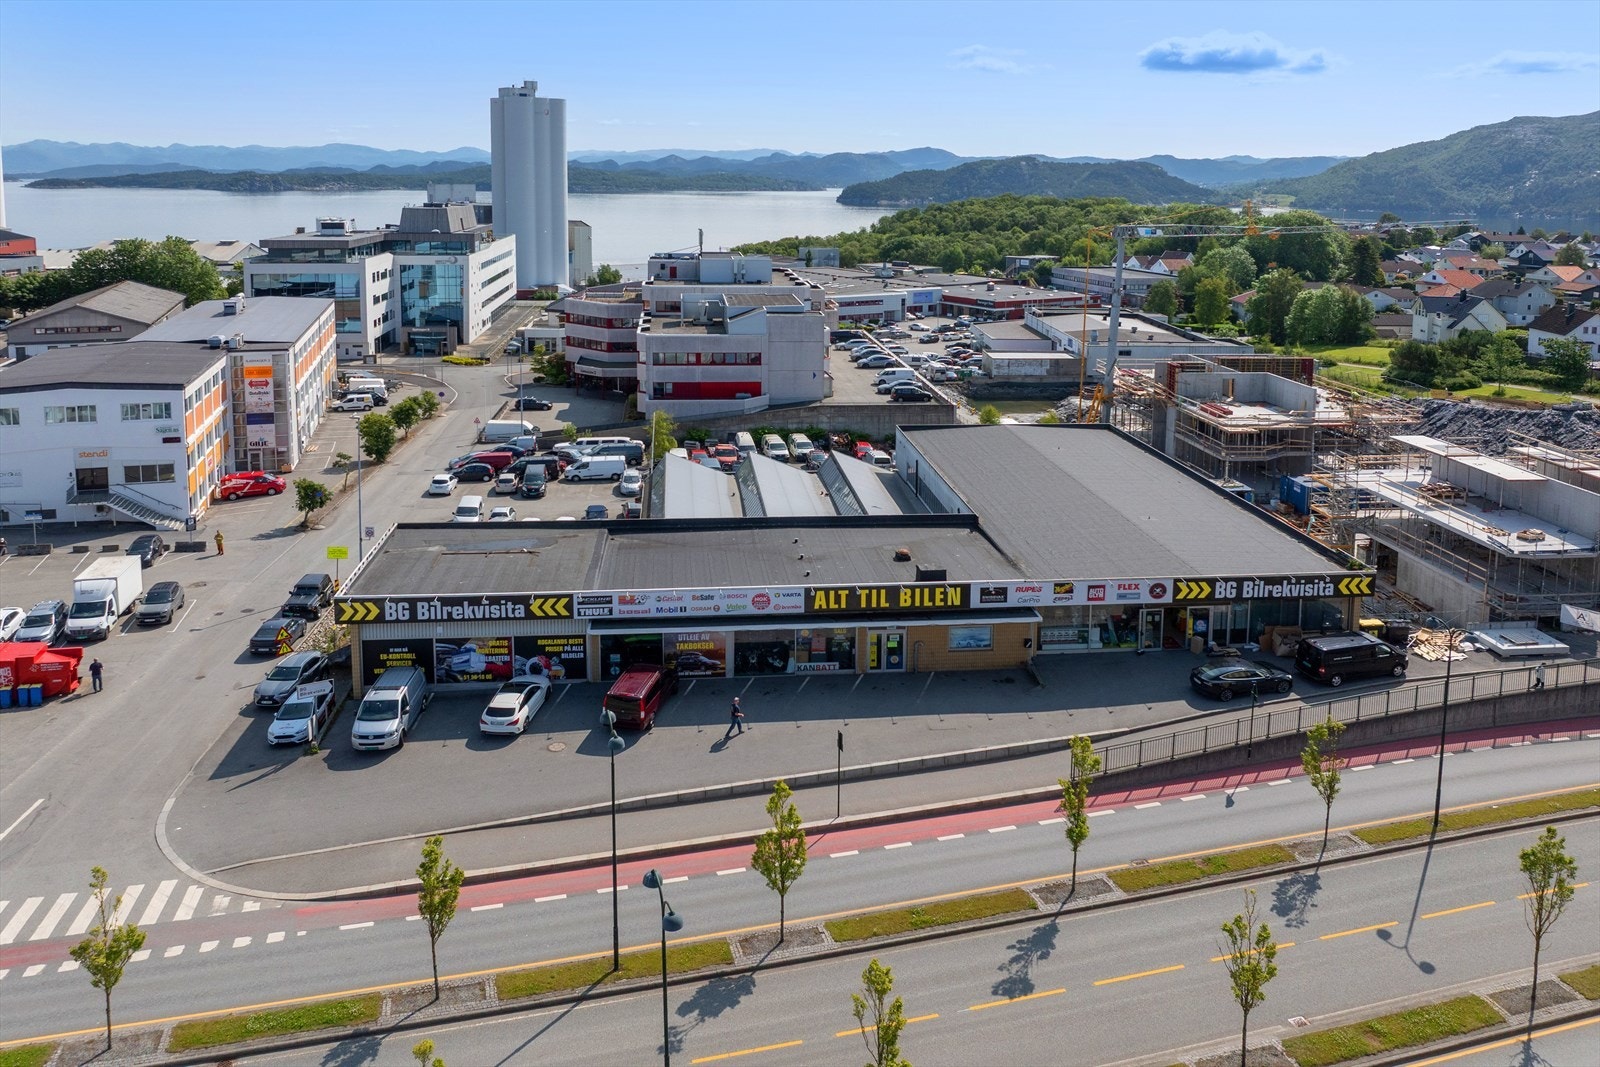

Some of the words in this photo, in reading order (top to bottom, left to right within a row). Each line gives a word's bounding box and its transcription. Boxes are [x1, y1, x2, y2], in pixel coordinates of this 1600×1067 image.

[79, 450, 108, 458] stendi
[1117, 583, 1140, 591] FLEX
[1215, 581, 1237, 599] BG
[1242, 579, 1334, 598] Bilrekvisita
[814, 590, 849, 609] ALT
[859, 589, 889, 608] TIL
[900, 587, 961, 607] BILEN
[384, 602, 409, 621] BG
[417, 600, 526, 620] Bilrekvisita
[579, 608, 610, 616] THULE
[676, 642, 714, 650] TAKBOKSER
[797, 663, 838, 672] KANBATT
